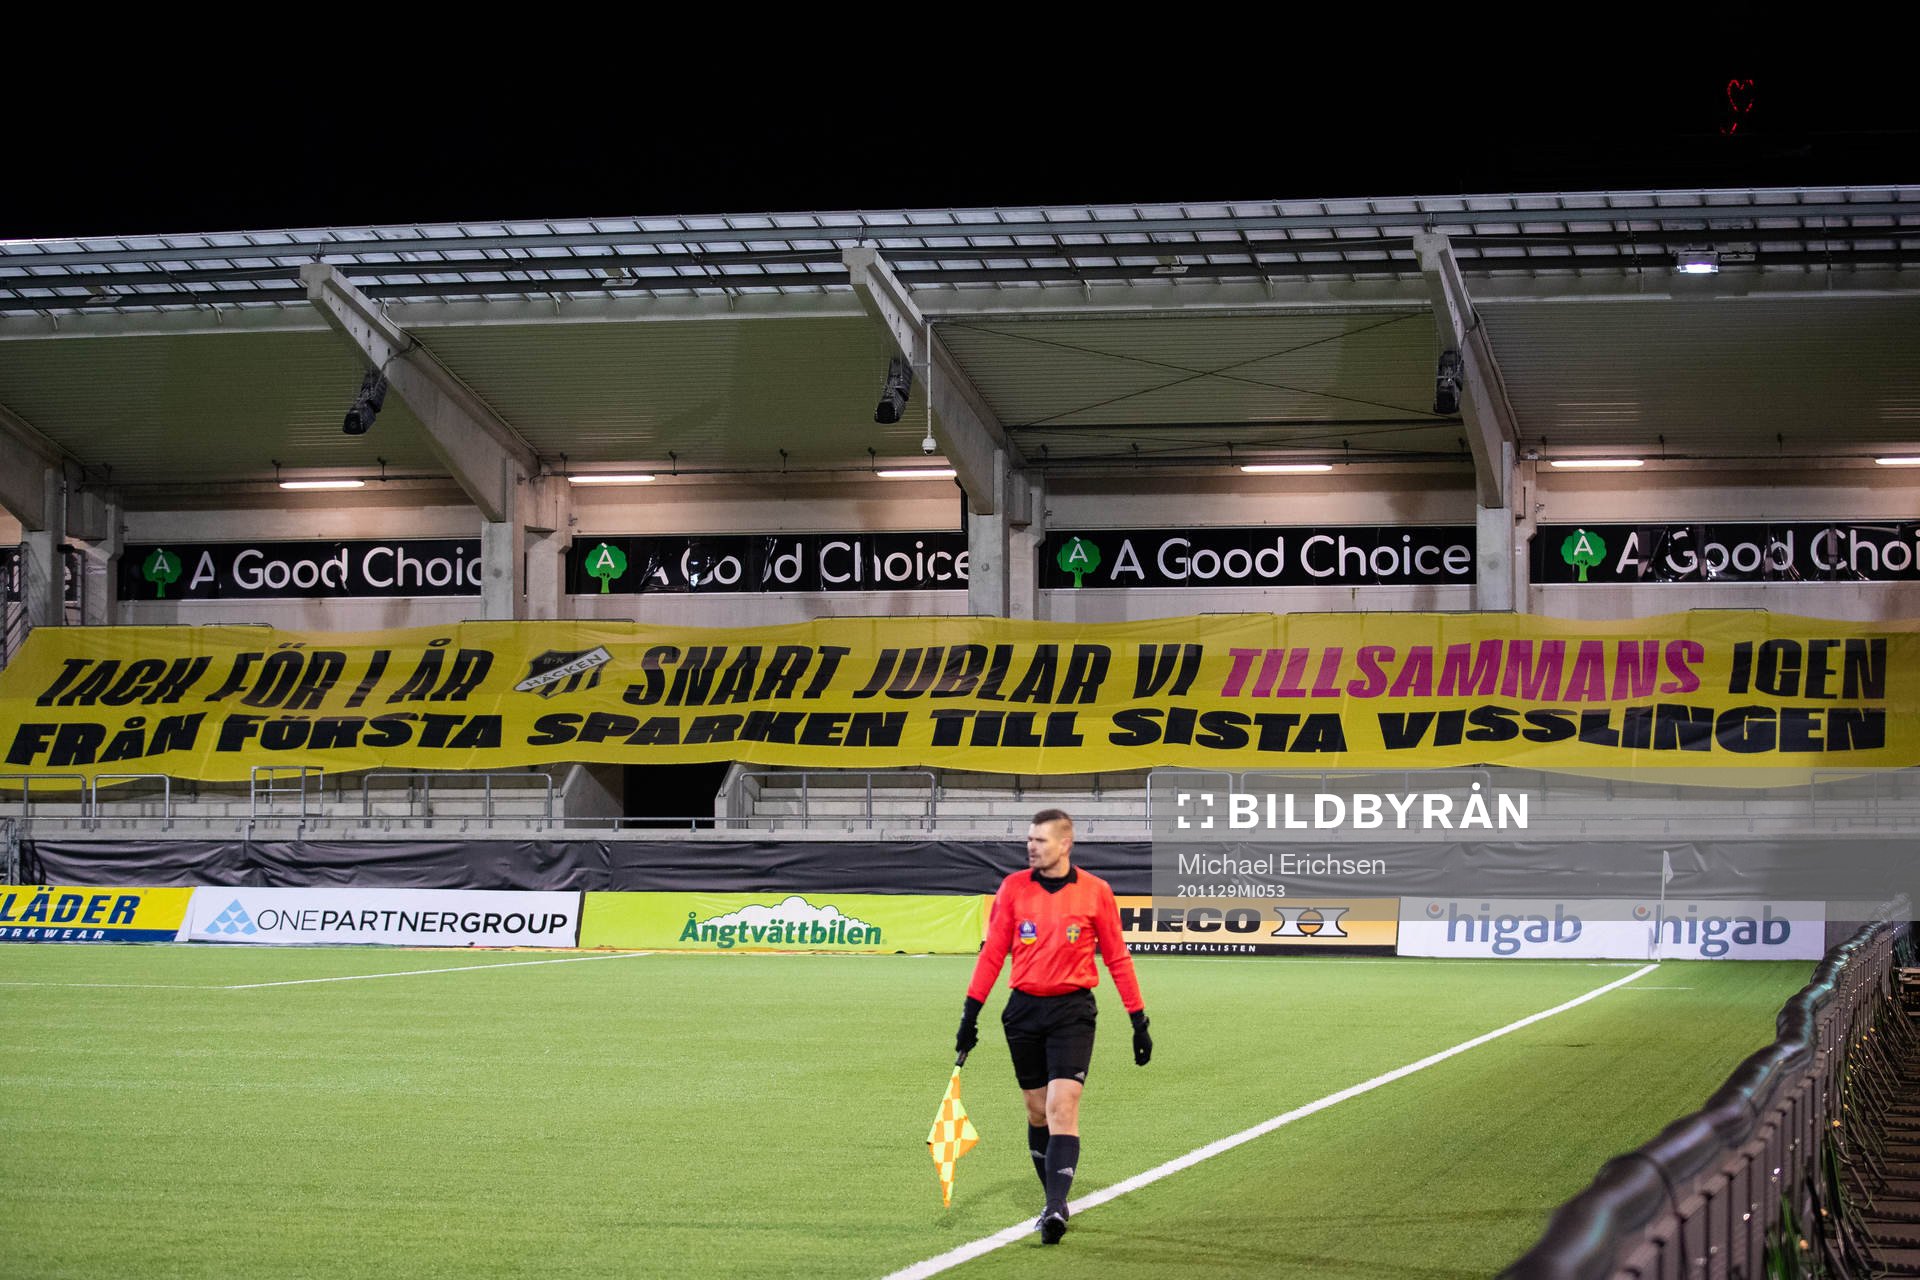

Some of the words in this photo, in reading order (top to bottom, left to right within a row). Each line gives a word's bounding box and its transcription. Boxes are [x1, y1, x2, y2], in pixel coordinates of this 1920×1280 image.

[233, 548, 348, 590] Good
[1110, 538, 1146, 581] A
[1157, 535, 1285, 580] Good
[1300, 533, 1472, 578] Choice
[35, 655, 214, 707] TACK
[203, 642, 347, 710] FÖR
[344, 650, 392, 708] I
[385, 638, 495, 704] ÅR
[622, 645, 851, 706] SNART
[852, 643, 1112, 704] JUBLAR
[1132, 643, 1204, 699] VI
[1220, 638, 1704, 701] TILLSAMMANS
[1728, 638, 1887, 700] IGEN
[5, 712, 209, 767] FRÅN
[527, 710, 908, 747] SPARKEN
[929, 708, 1084, 748] TILL
[1108, 707, 1348, 753] SISTA
[1377, 703, 1887, 754] VISSLINGEN
[0, 886, 141, 925] LÄDER
[257, 909, 568, 934] ONEPARTNERGROUP
[679, 911, 881, 948] Ångtvättbilen
[1120, 907, 1261, 933] HECO
[1447, 903, 1582, 955] higab
[1655, 904, 1791, 957] higab
